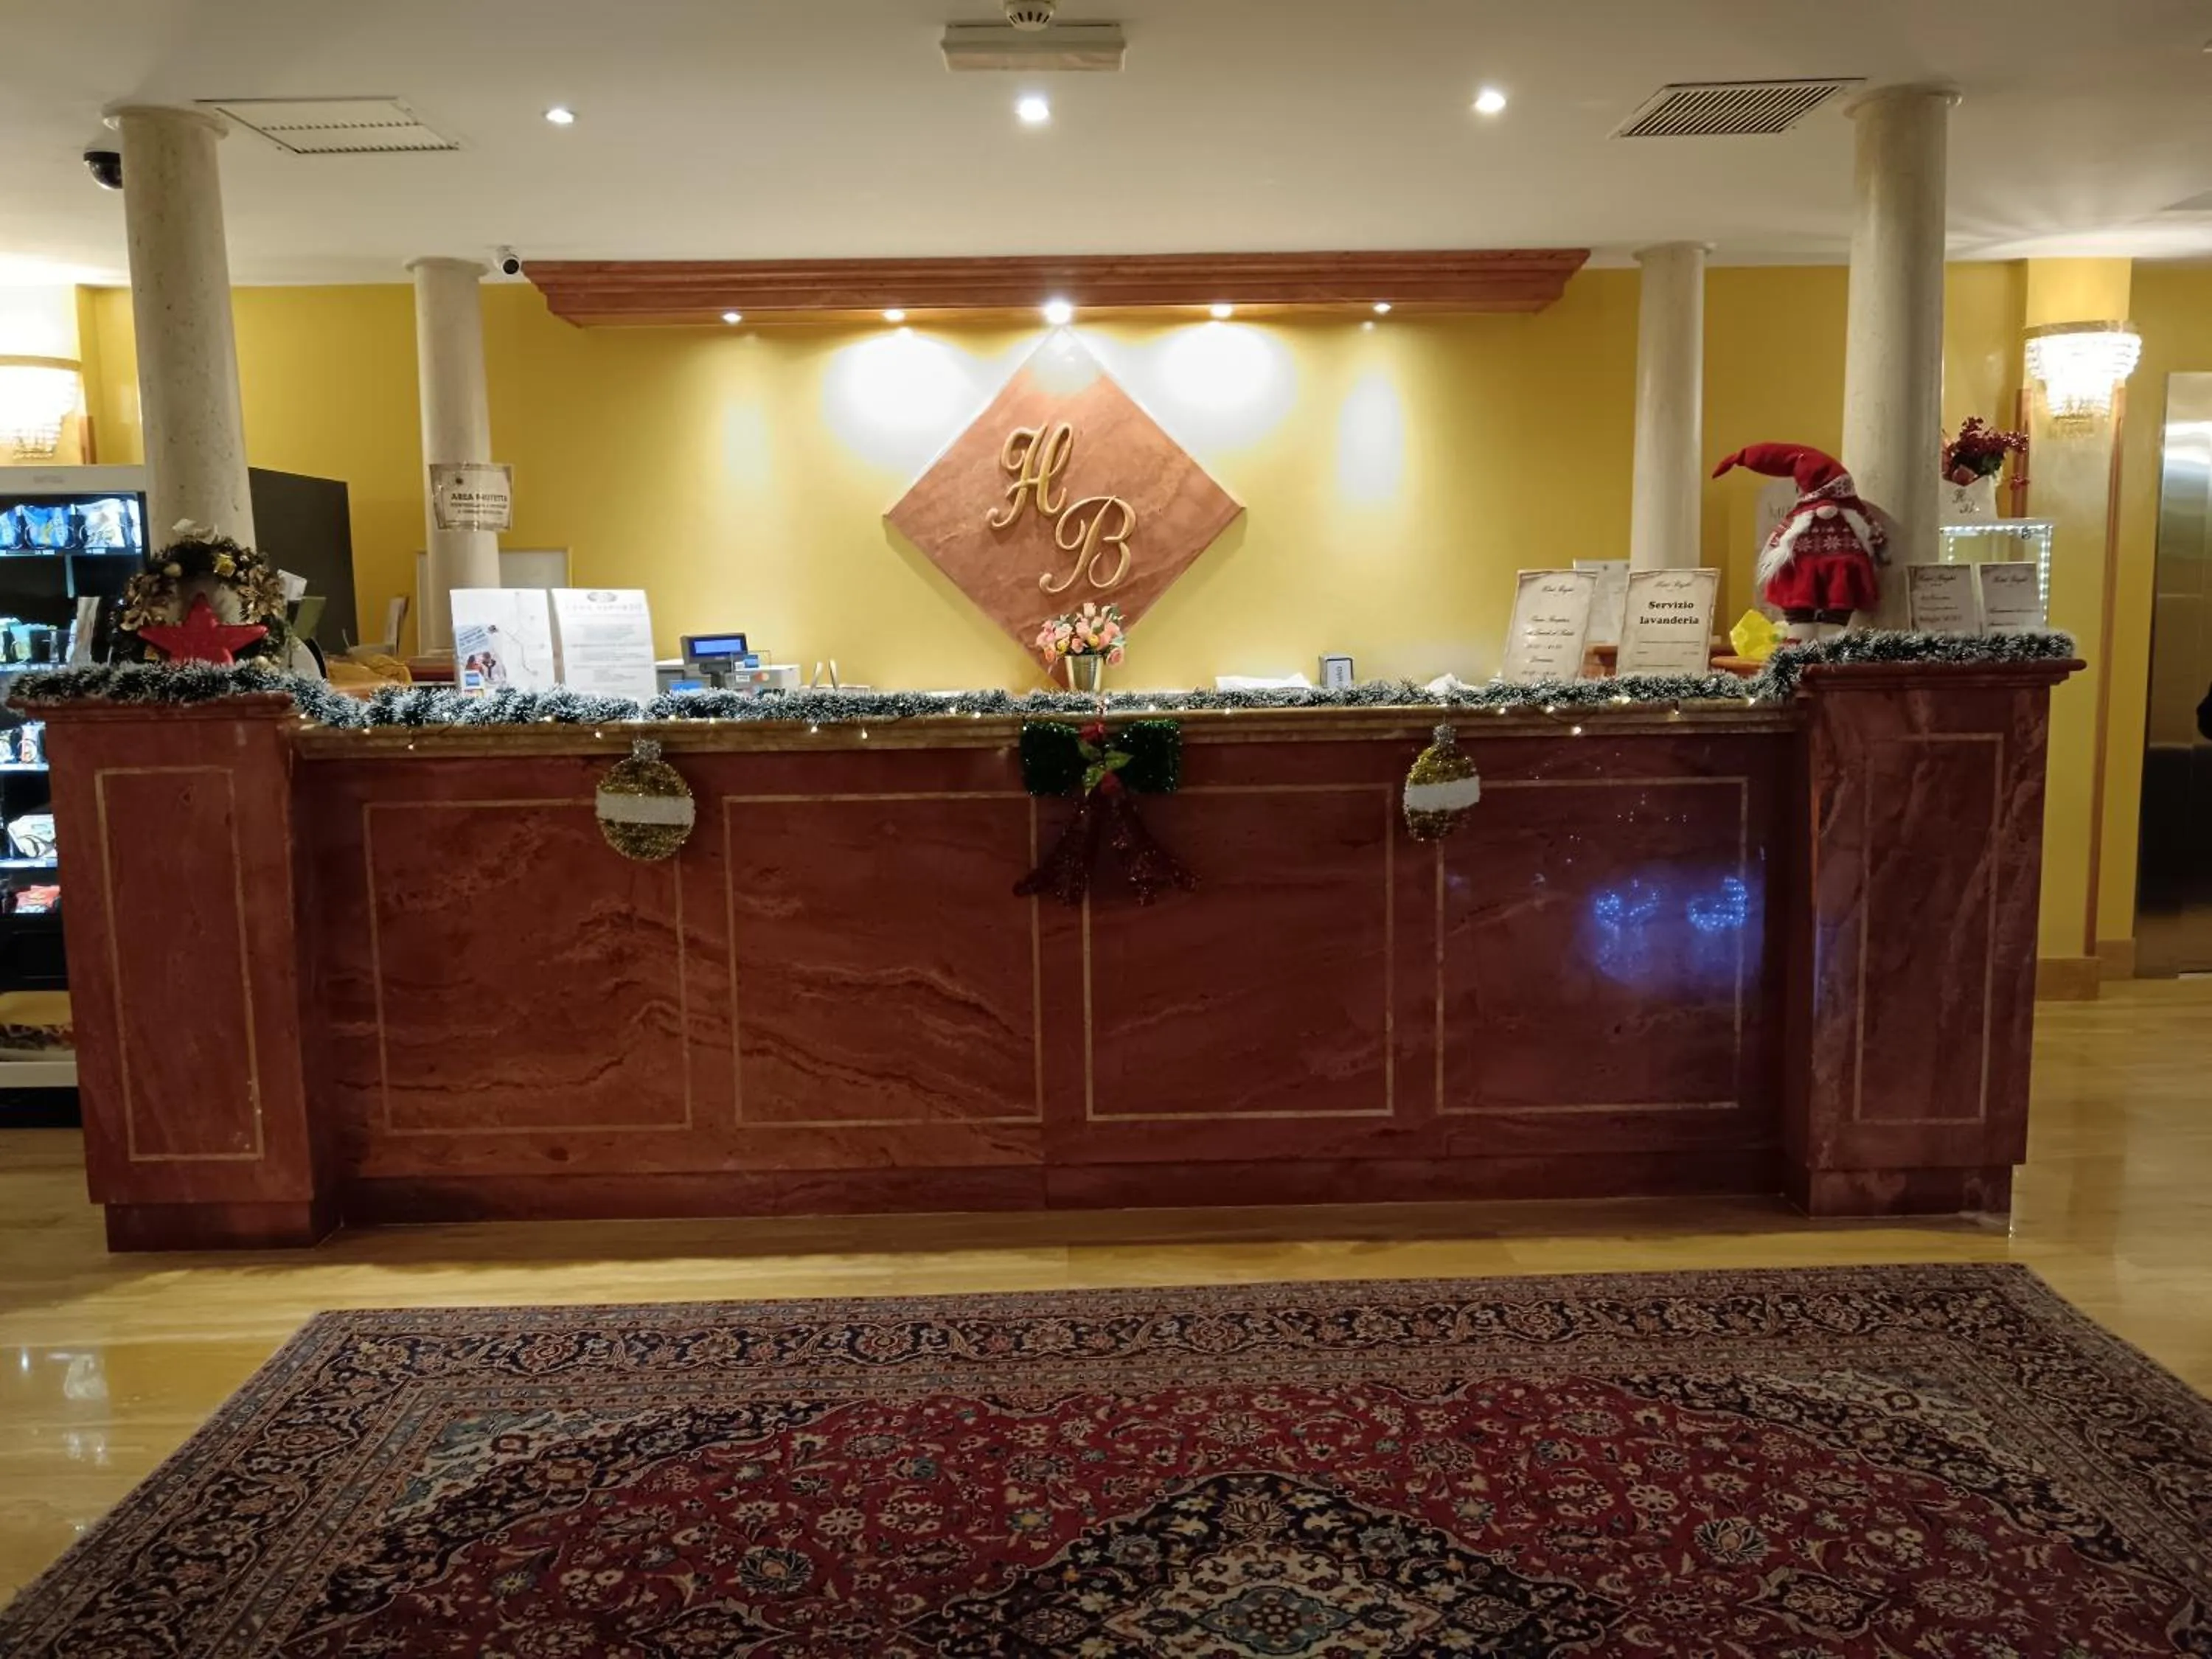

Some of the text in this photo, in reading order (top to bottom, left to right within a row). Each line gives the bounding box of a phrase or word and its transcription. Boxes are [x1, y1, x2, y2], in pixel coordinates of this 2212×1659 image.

[986, 422, 1074, 531] H
[451, 493, 473, 501] AREA
[1039, 495, 1137, 593] B
[1648, 601, 1694, 610] Servizio
[1639, 616, 1700, 625] lavanderia
